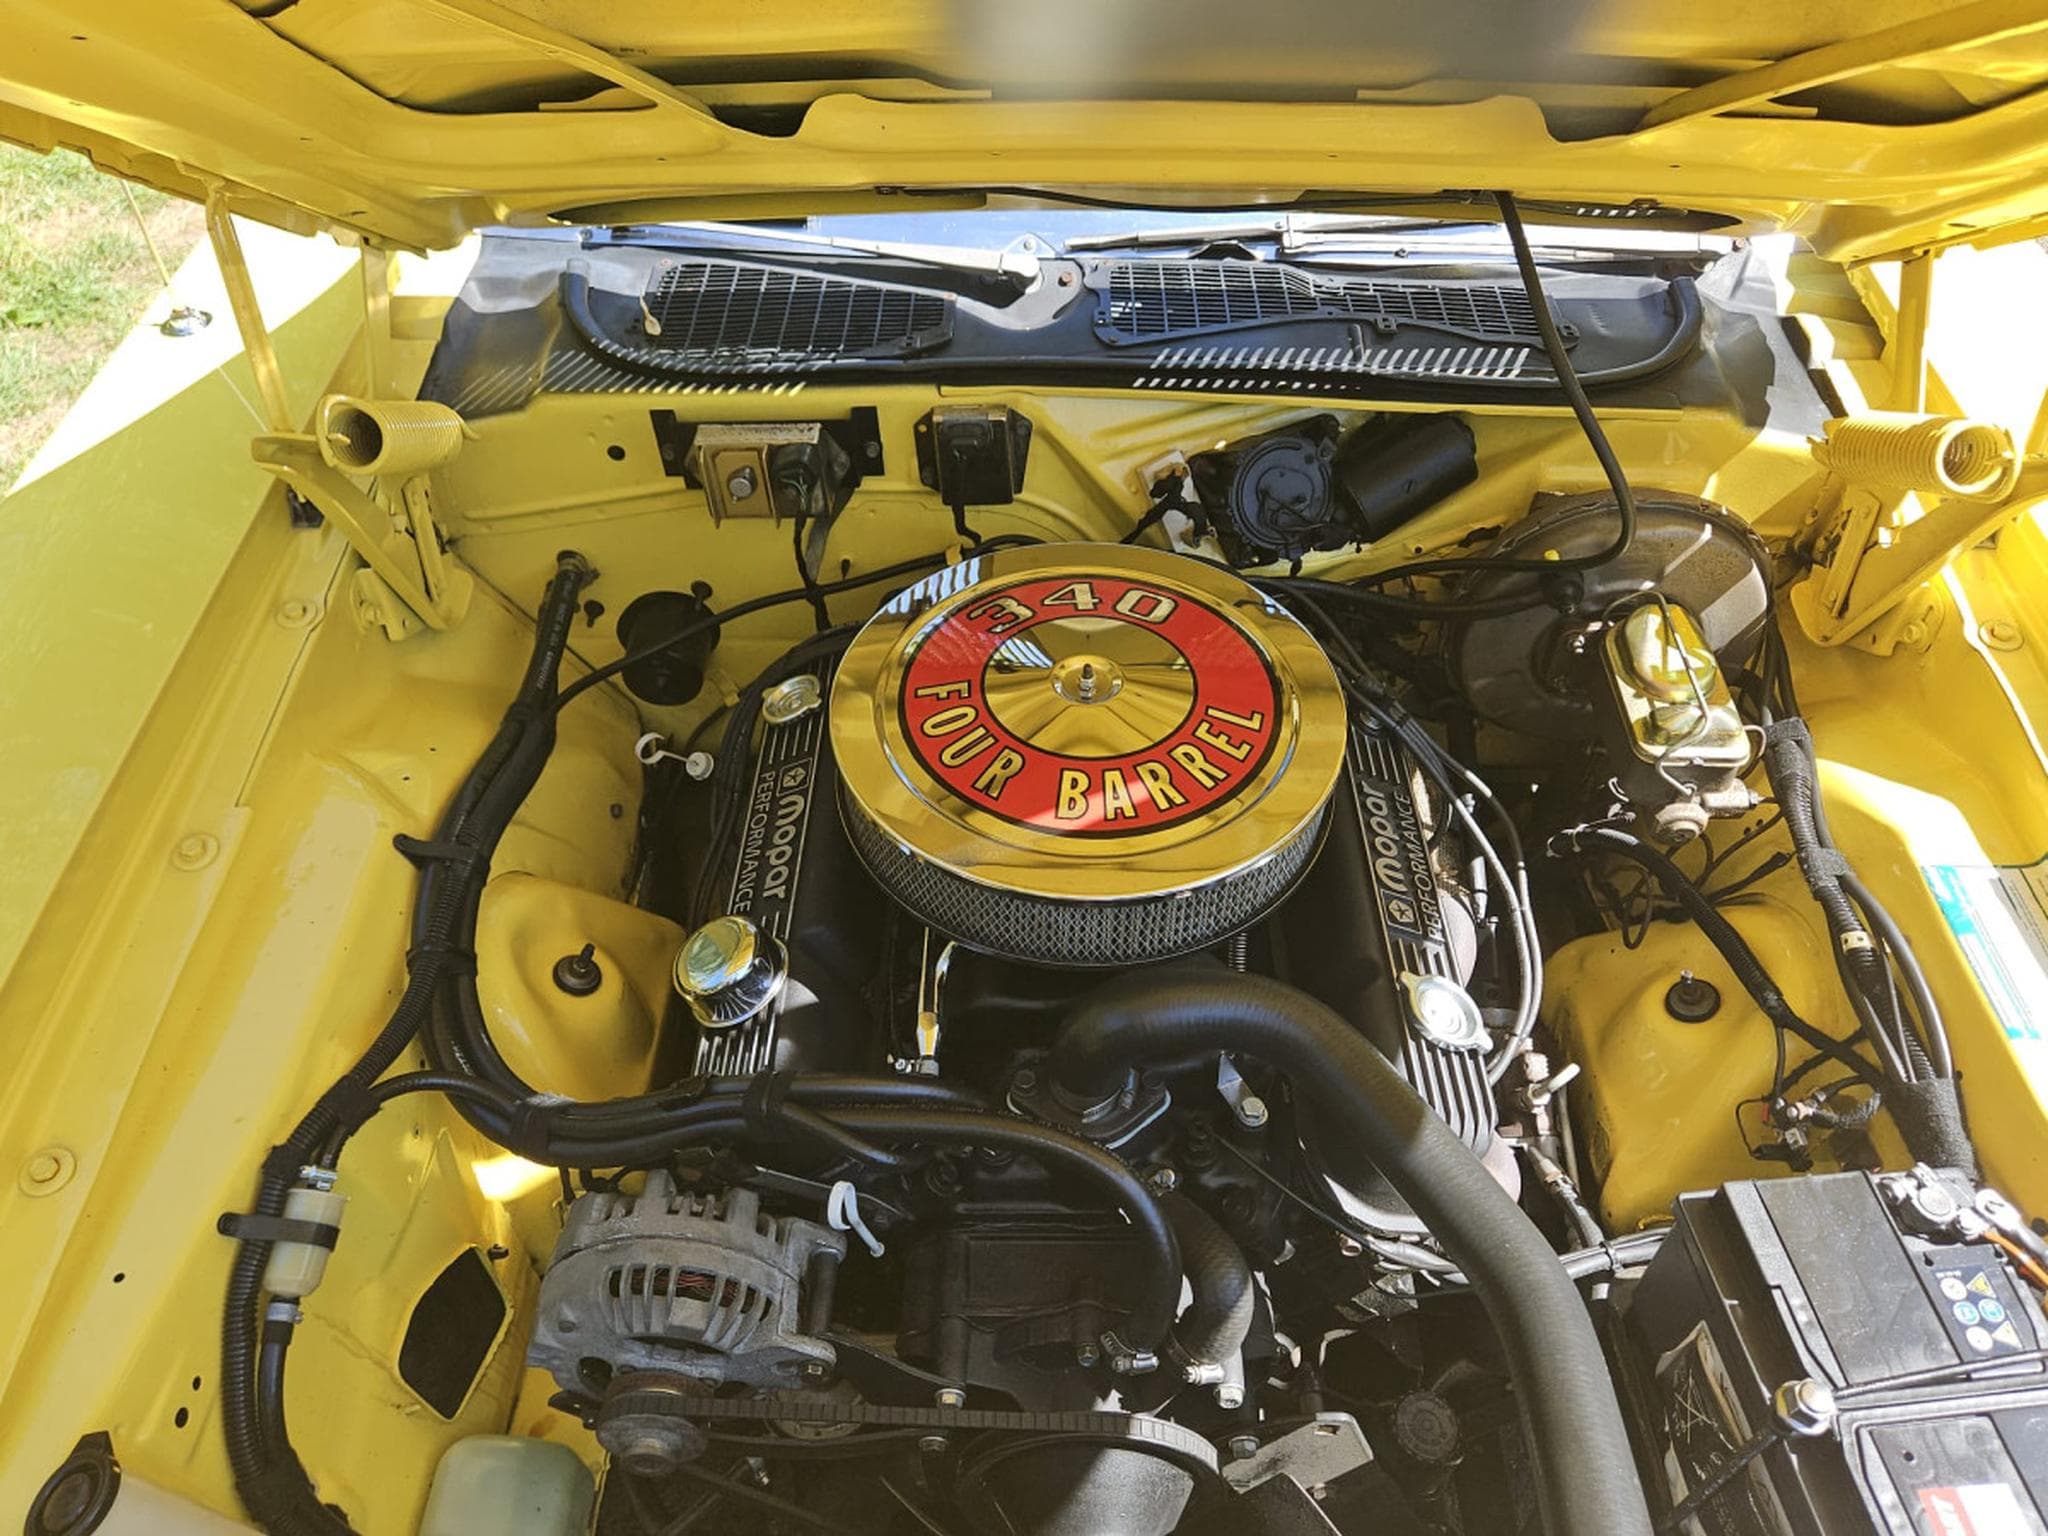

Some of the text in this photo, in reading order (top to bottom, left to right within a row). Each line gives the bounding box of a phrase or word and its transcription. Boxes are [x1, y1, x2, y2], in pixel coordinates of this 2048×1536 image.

[967, 582, 1176, 634] 340
[914, 680, 1263, 821] FOUR BARREL
[733, 770, 776, 914] PERFORMANCE
[1393, 789, 1445, 943] PERFORMANCE
